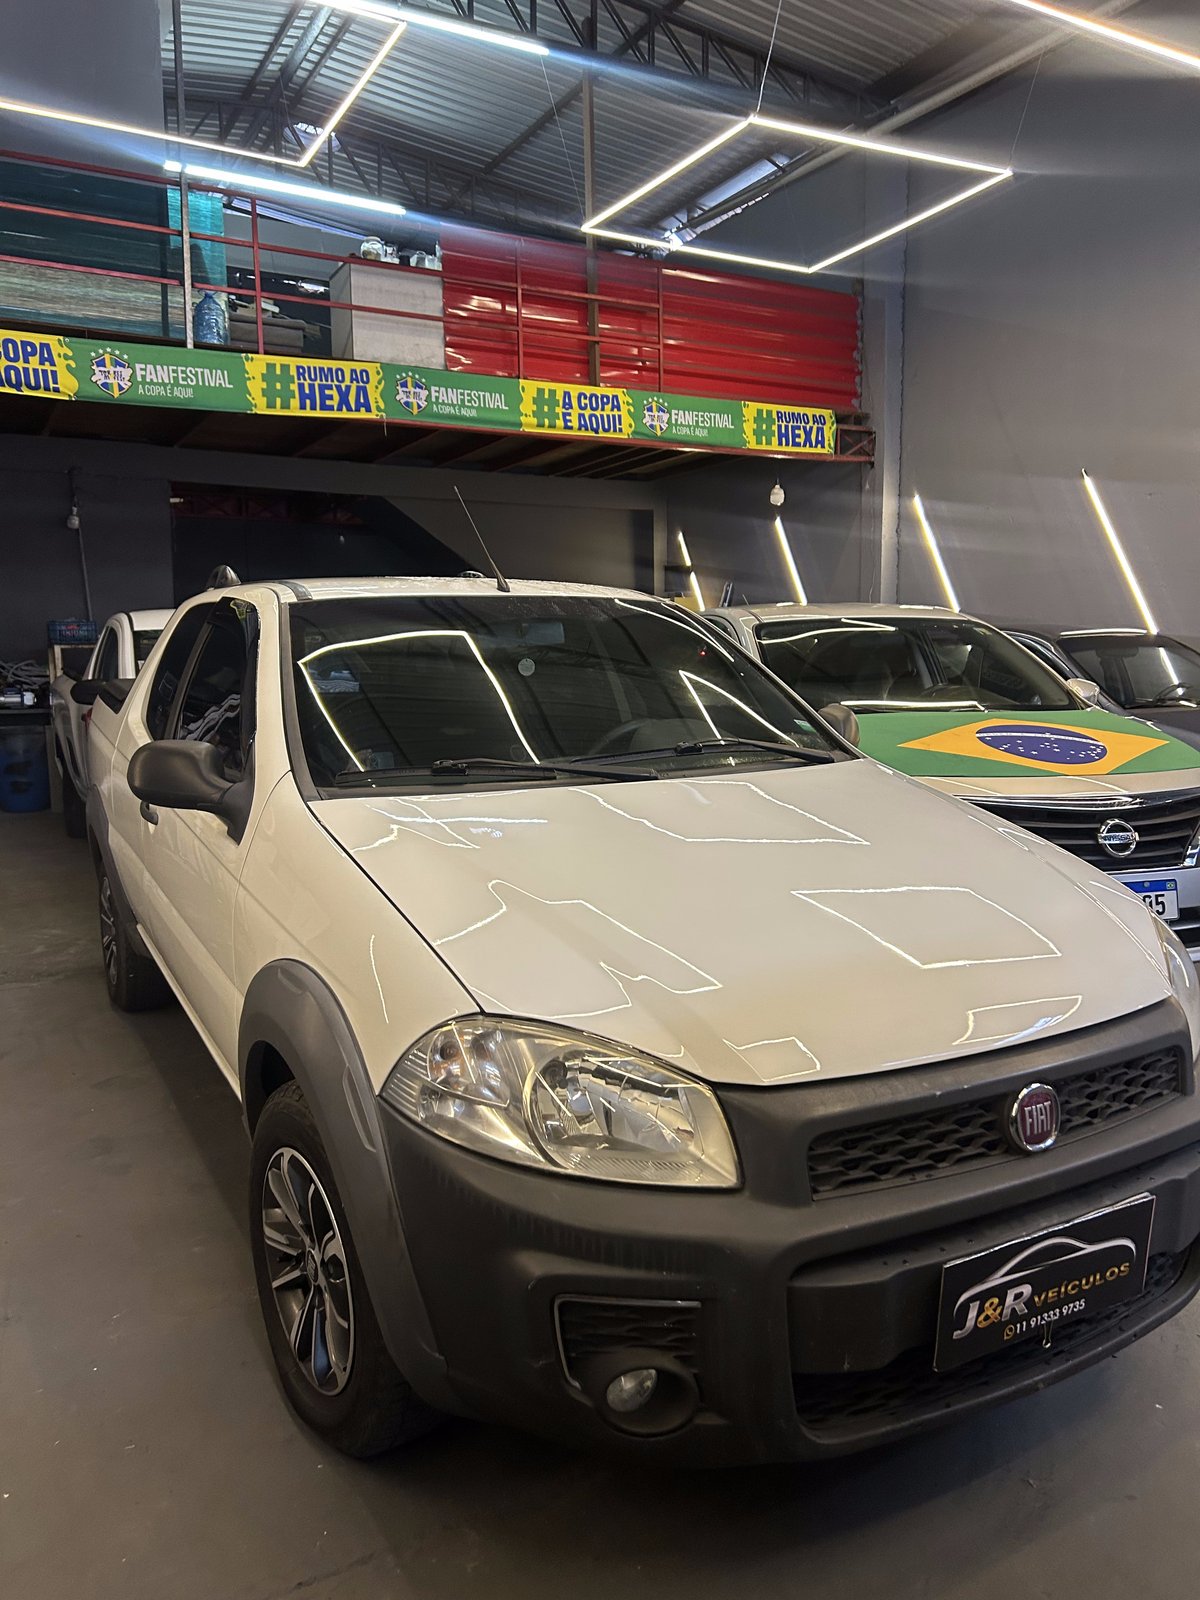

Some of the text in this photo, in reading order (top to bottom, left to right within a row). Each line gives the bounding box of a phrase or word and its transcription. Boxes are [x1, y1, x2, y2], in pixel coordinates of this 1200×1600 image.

[0, 338, 57, 367] OPA
[296, 365, 371, 385] RUMO AO
[138, 385, 145, 395] A
[145, 385, 166, 397] COPA
[167, 383, 172, 397] É
[297, 382, 373, 413] HEXA
[562, 390, 622, 412] A COPA
[432, 404, 438, 413] A
[439, 404, 455, 415] COPA
[776, 411, 827, 426] RUMO AO
[578, 412, 624, 434] AQUI!
[777, 424, 826, 449] HEXA
[1024, 1101, 1051, 1136] FIAT
[953, 1262, 1131, 1340] J&R VEÍCULOS
[1016, 1299, 1086, 1334] 11 91333 9735
